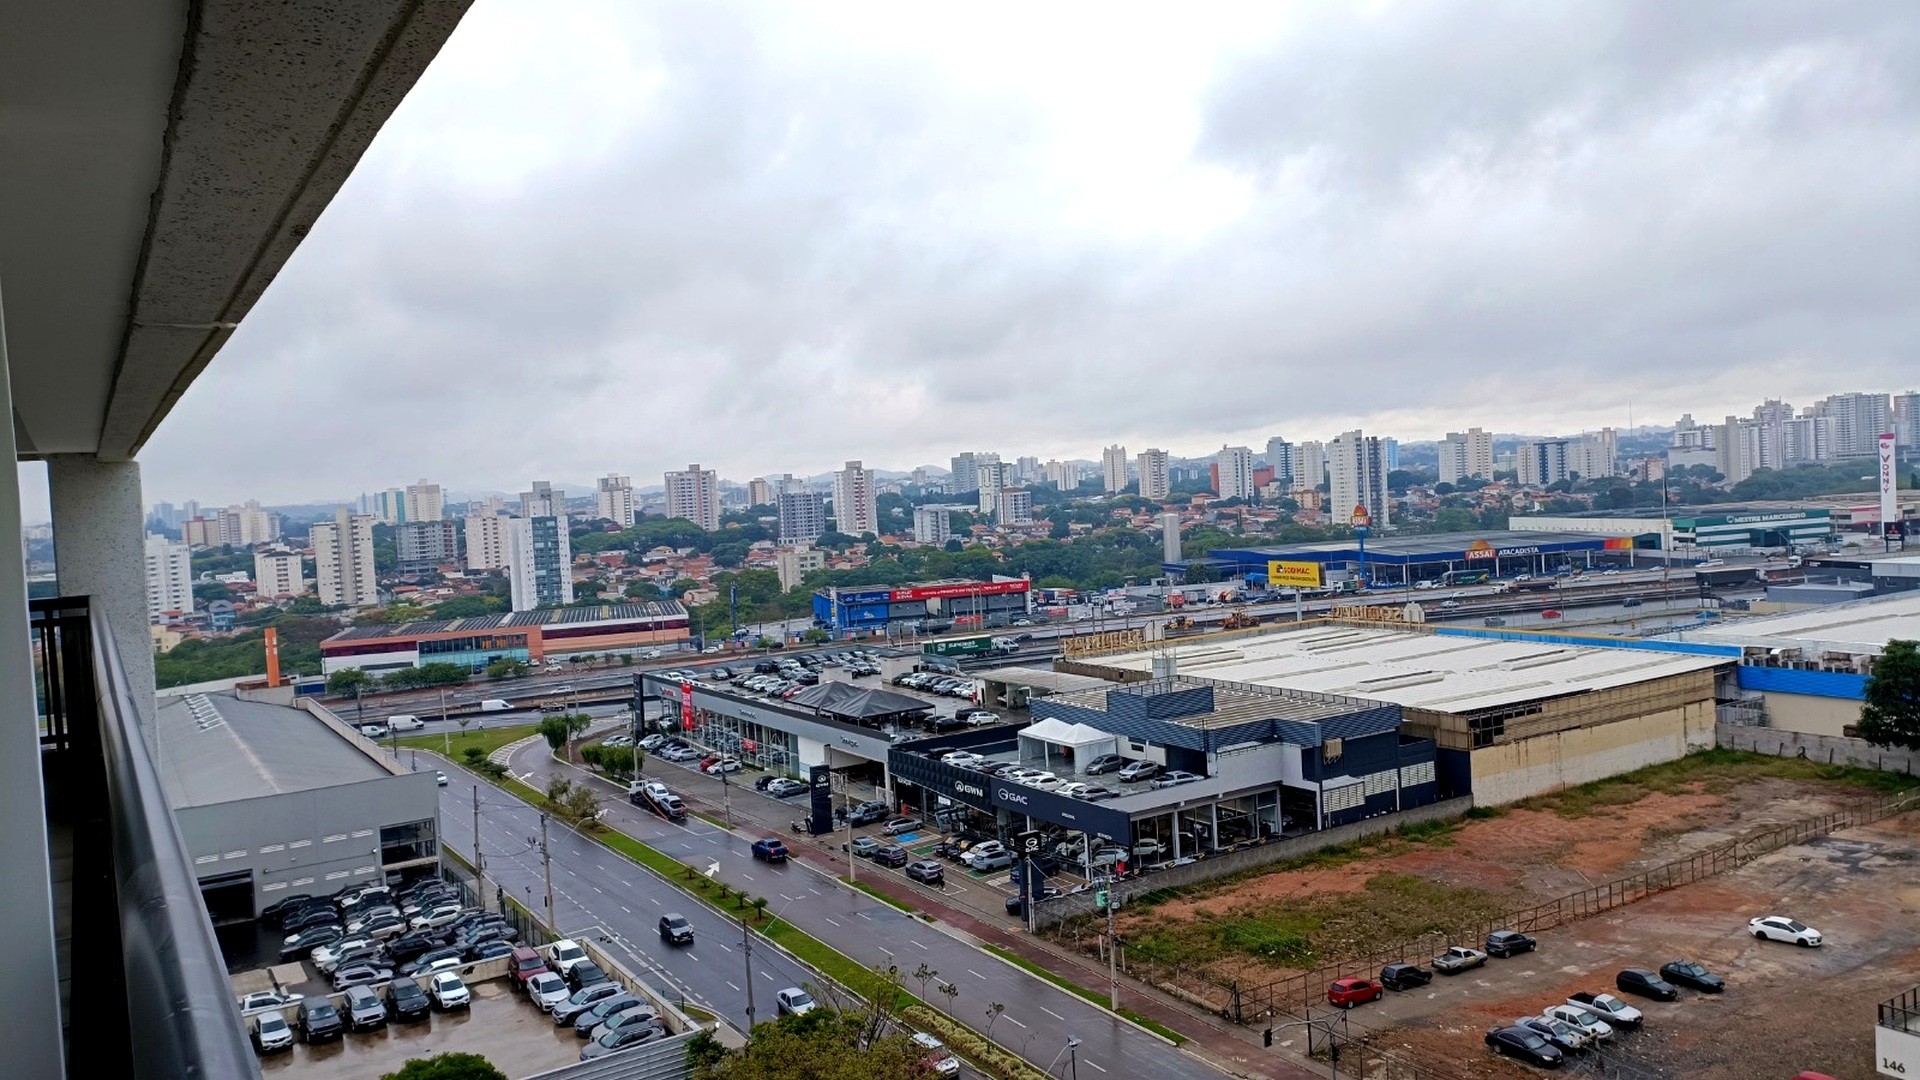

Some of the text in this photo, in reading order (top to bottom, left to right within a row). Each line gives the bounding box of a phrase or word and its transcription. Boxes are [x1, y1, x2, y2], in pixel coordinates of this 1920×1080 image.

[1498, 547, 1539, 556] ATACADISTA
[964, 784, 984, 797] GWM
[1008, 792, 1028, 805] GAC
[1883, 1057, 1905, 1074] 146
